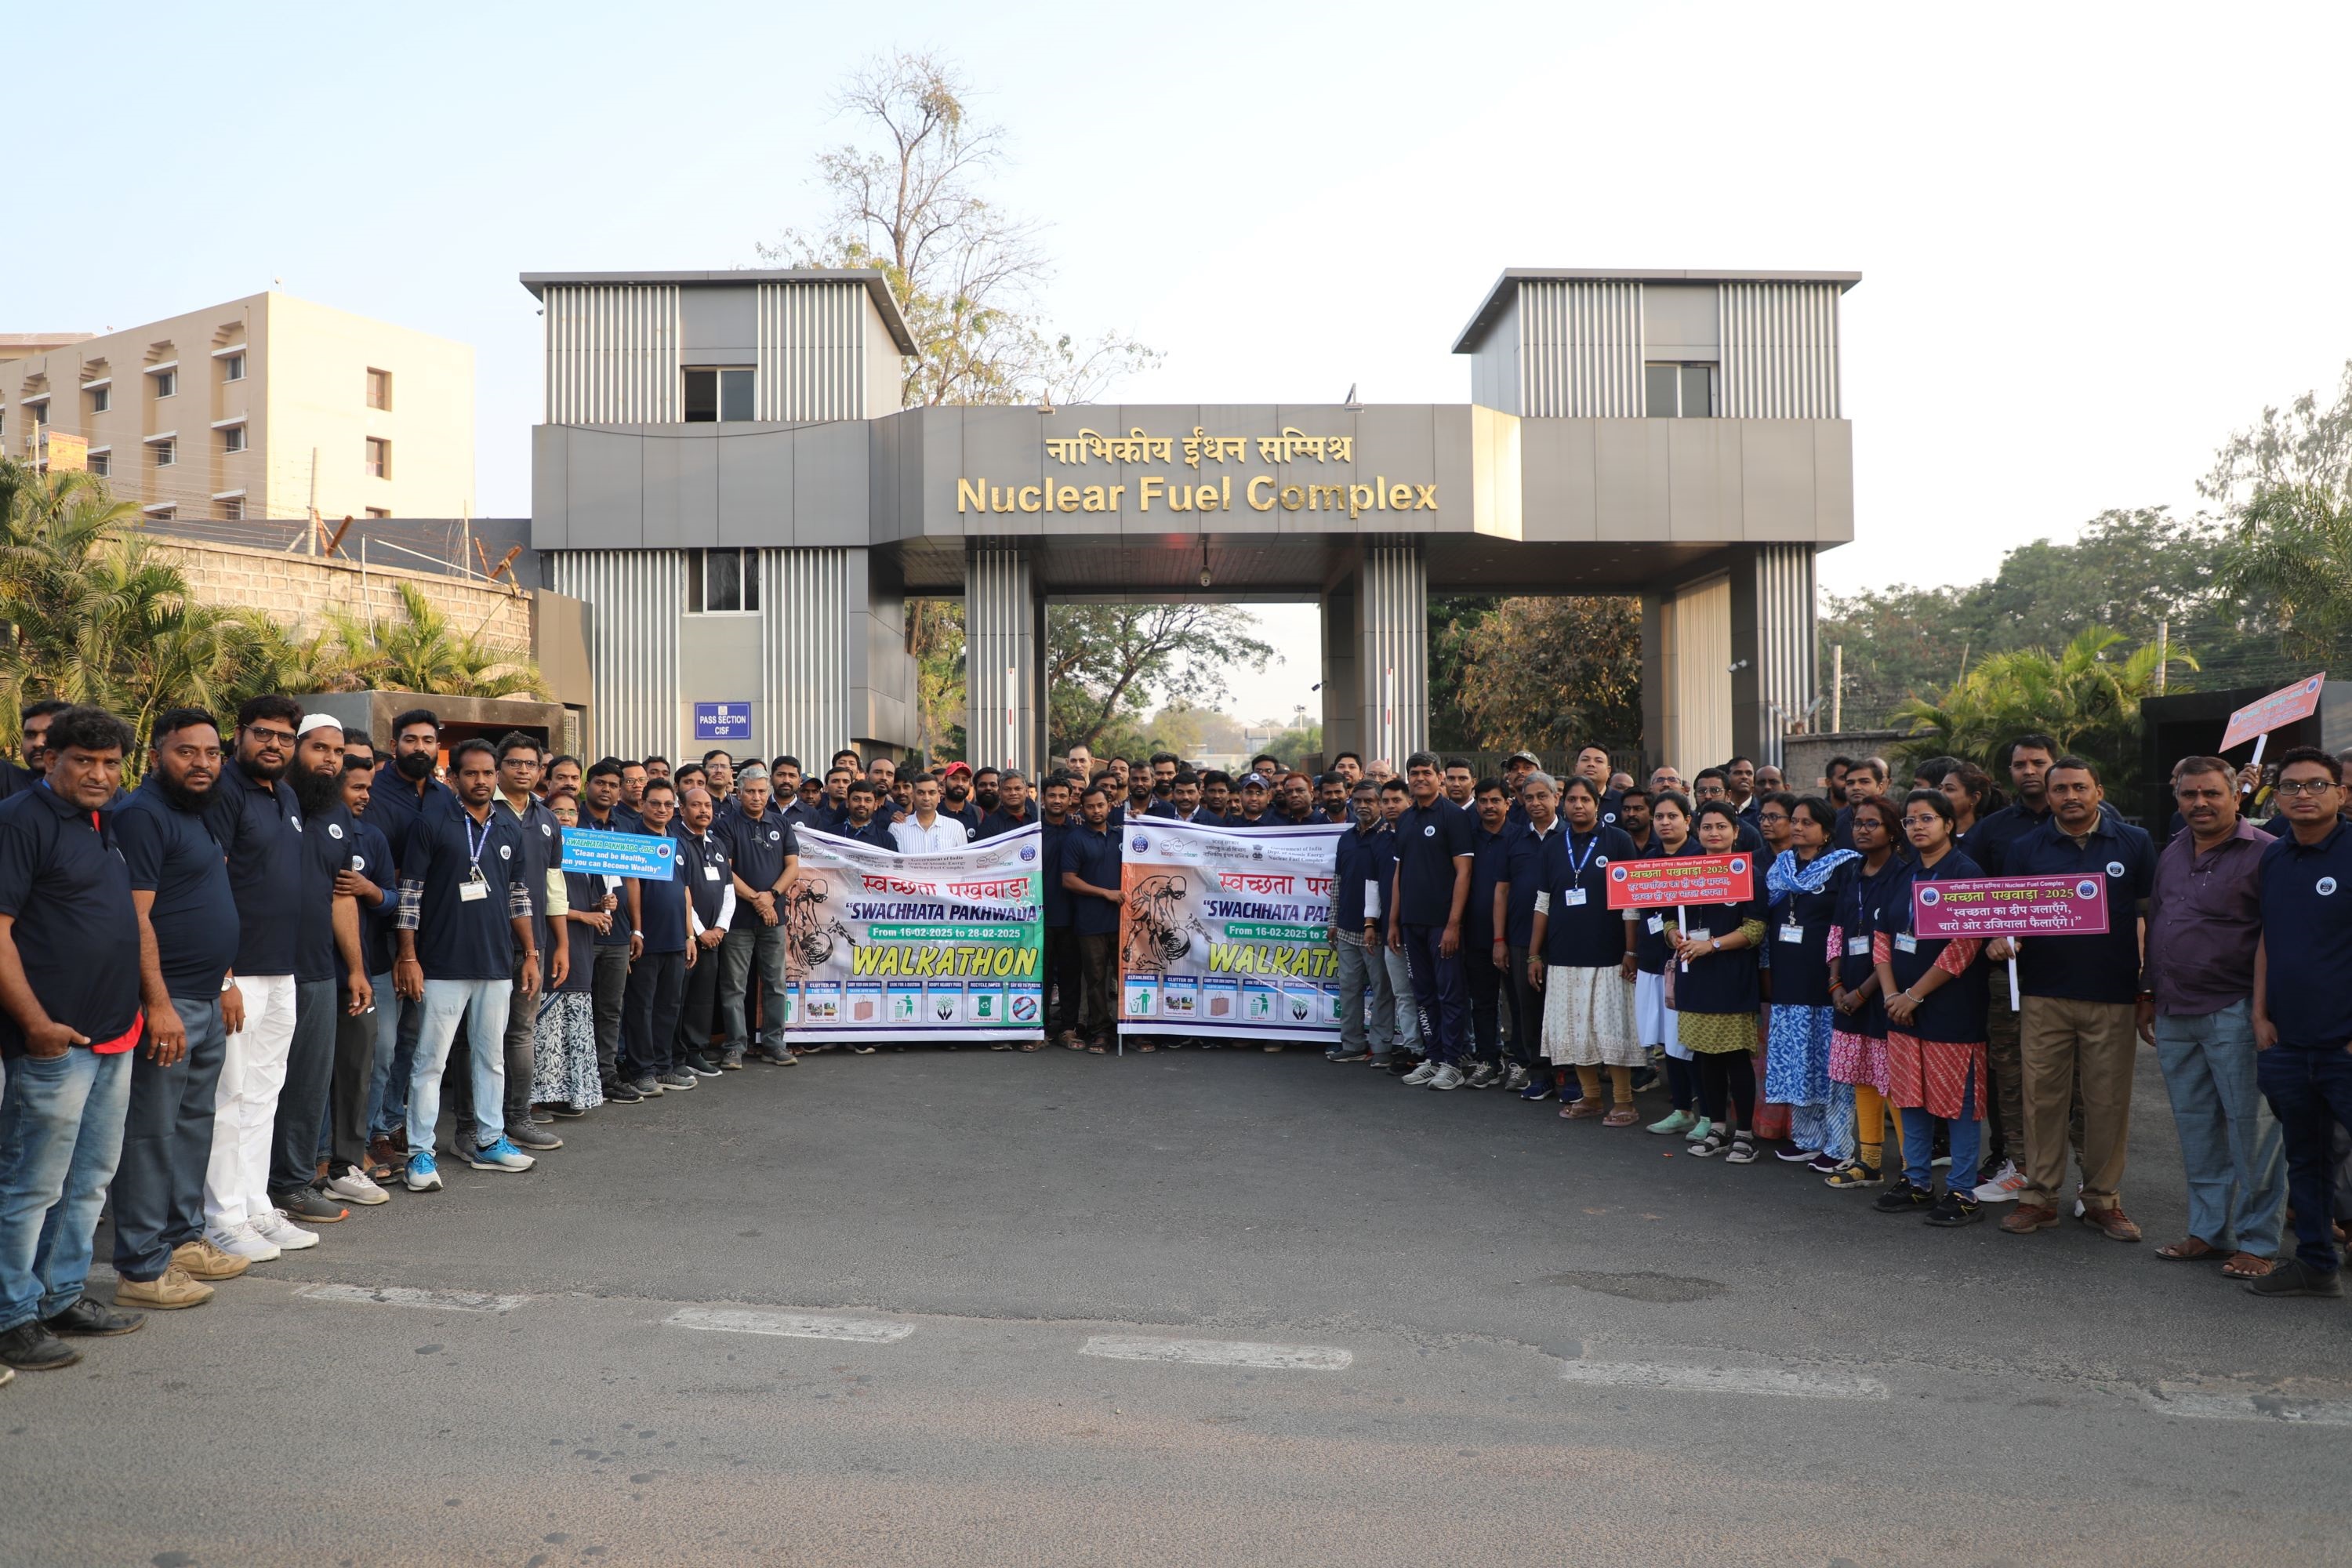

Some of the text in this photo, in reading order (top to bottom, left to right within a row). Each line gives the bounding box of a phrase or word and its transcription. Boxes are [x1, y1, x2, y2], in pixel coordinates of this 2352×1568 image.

[1046, 426, 1352, 469] नाभिकीय ईंधन सम्मिश्र
[957, 475, 1439, 520] Nuclear Fuel Complex
[699, 715, 746, 724] PASS SECTION
[714, 726, 729, 735] CISF
[575, 858, 587, 867] you
[603, 860, 629, 870] Become
[597, 851, 608, 859] and
[620, 853, 648, 864] Healthy,
[1629, 869, 1661, 879] स्वच्छता
[1666, 866, 1702, 877] पखवाड़ा
[861, 874, 1029, 902] स्वच्छता पखवाड़ा
[1218, 873, 1295, 895] स्वच्छता
[1942, 888, 2074, 903] स्वच्छता पखवाड़ा -2025
[1992, 906, 2006, 915] का
[2009, 902, 2027, 916] दीप
[1962, 919, 1981, 930] ओर
[1985, 917, 2027, 929] उजियाला
[2030, 916, 2068, 927] फैलाएँगे
[873, 927, 1021, 938] From 16-02-2025 to 28-02-2025
[1229, 926, 1252, 935] From
[1255, 927, 1307, 938] 16-02-2025
[1309, 930, 1319, 938] to
[852, 945, 1038, 978] WALKATHON
